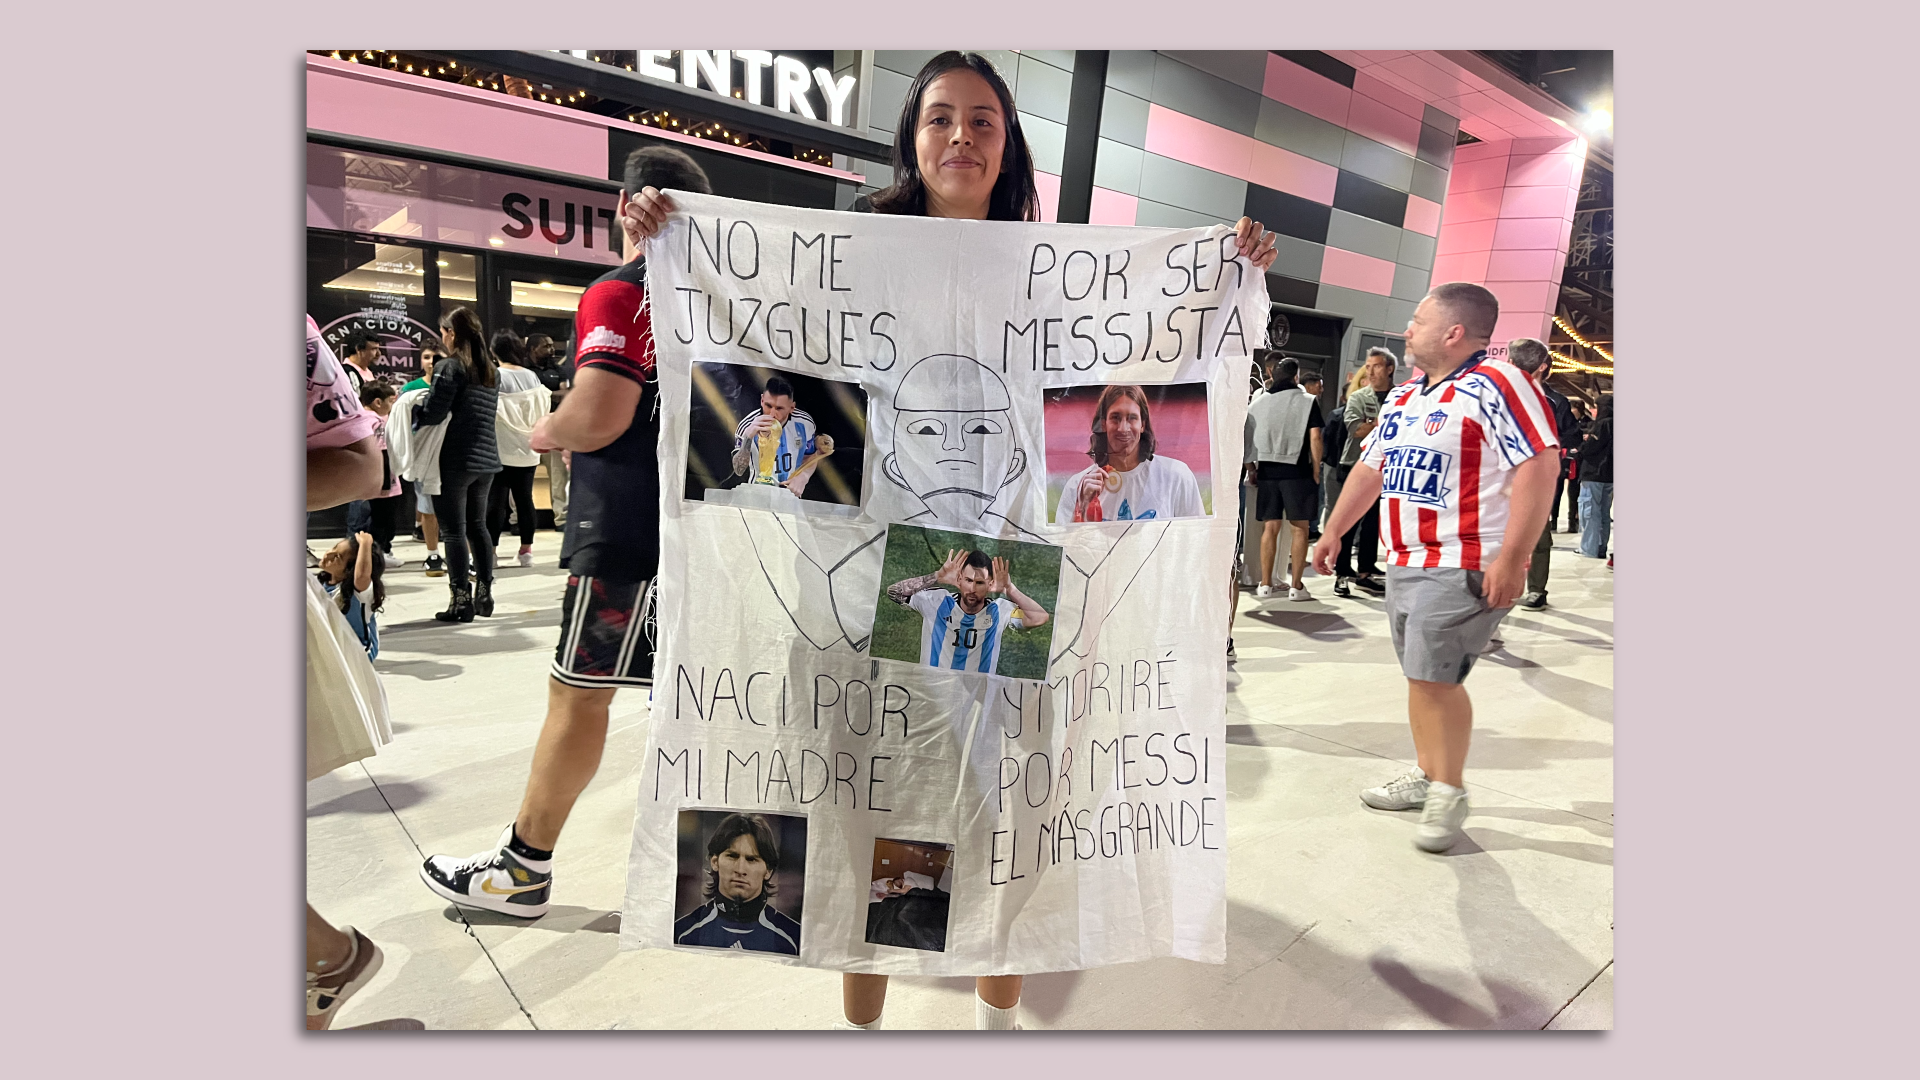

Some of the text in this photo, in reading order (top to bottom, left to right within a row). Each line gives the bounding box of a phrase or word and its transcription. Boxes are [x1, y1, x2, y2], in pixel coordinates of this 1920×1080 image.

[639, 50, 856, 126] ENTRY
[686, 216, 853, 292] NO ME
[1027, 232, 1243, 300] POR SER
[327, 320, 422, 345] RNACIONA
[375, 355, 414, 368] AMI
[674, 286, 897, 372] JUZGUES
[1003, 305, 1249, 373] MESSISTA
[1488, 347, 1508, 356] IDFI
[774, 452, 792, 474] 10
[1382, 467, 1438, 498] GUILA
[1383, 448, 1442, 474] ERVEZA
[951, 628, 978, 649] 10
[674, 664, 912, 737] NACI POR
[1038, 651, 1178, 736] MORIRÉ
[654, 747, 893, 813] MI MADRE
[998, 732, 1209, 813] POR MESSI
[990, 830, 1026, 887] EL
